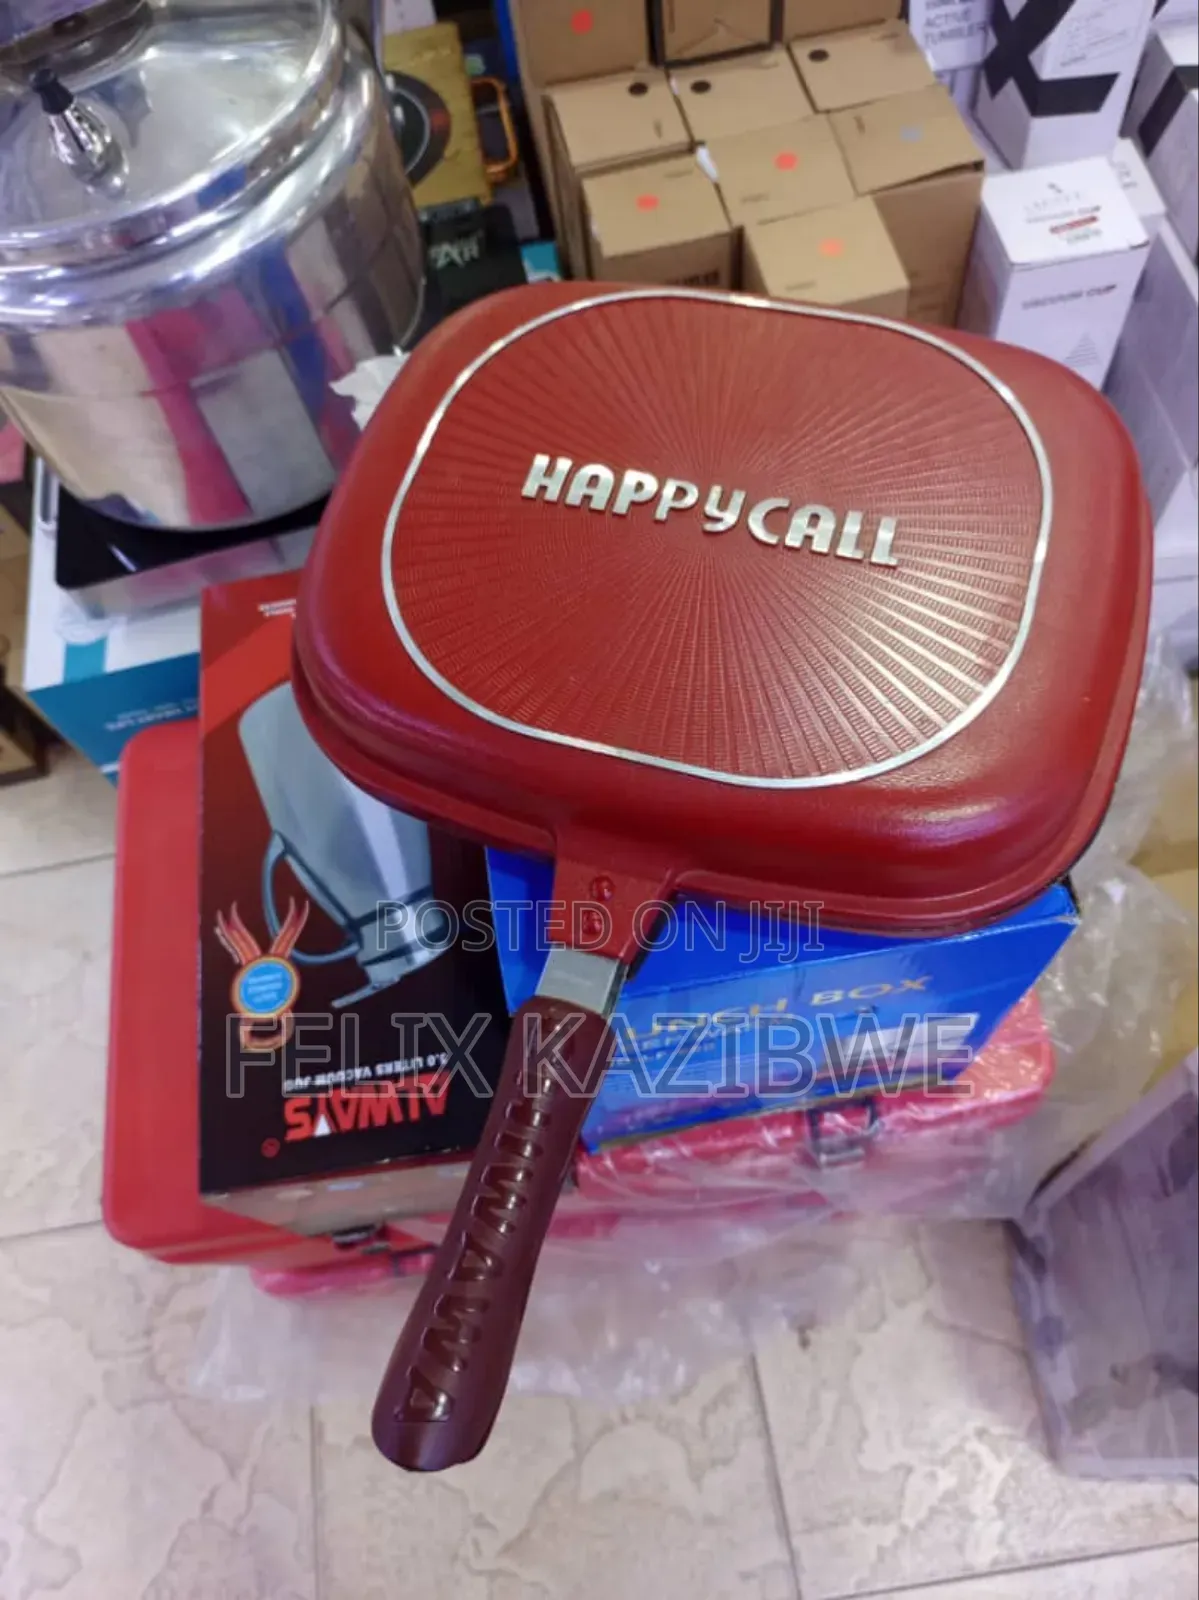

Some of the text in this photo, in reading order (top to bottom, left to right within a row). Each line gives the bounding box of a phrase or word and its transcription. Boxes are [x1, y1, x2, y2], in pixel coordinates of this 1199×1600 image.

[521, 452, 899, 567] HAPPYCALL
[810, 975, 933, 1006] BOX
[314, 1065, 373, 1087] VACUUM
[375, 1056, 424, 1077] LITERS
[284, 1075, 312, 1093] JUG
[284, 1070, 450, 1142] ALWAYS
